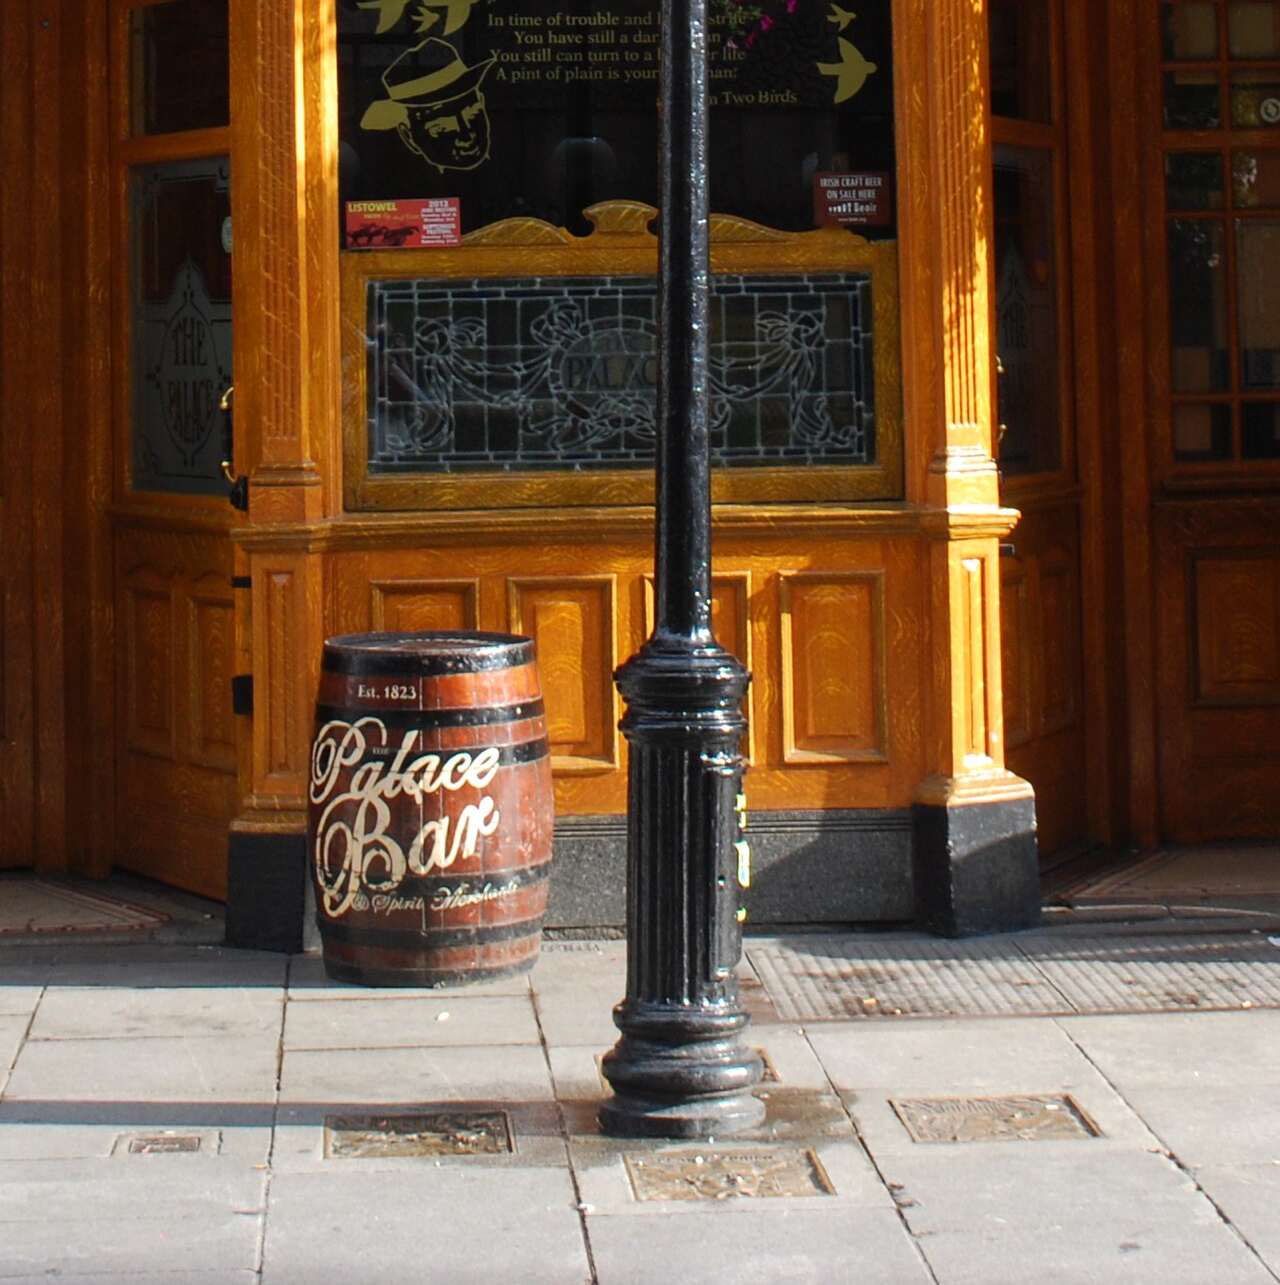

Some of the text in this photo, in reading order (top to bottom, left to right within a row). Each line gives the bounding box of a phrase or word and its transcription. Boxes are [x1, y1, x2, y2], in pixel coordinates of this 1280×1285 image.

[488, 14, 504, 26] In
[509, 13, 542, 26] time
[547, 12, 562, 26] of
[565, 13, 619, 26] trouble
[624, 13, 652, 26] and
[514, 31, 543, 44] You
[548, 31, 583, 44] have
[587, 31, 615, 44] still
[620, 34, 628, 44] a
[490, 49, 519, 62] You
[524, 48, 551, 62] still
[556, 52, 583, 62] can
[588, 51, 620, 62] turn
[624, 51, 639, 62] to
[644, 53, 652, 62] a
[723, 46, 745, 60] life
[496, 68, 507, 80] A
[512, 67, 540, 83] pint
[546, 66, 561, 80] of
[566, 66, 603, 83] plain
[608, 67, 620, 80] is
[624, 70, 658, 84] your
[721, 90, 755, 104] Two
[758, 89, 798, 104] Birds
[820, 177, 882, 187] IRISH CRAFT BEER
[826, 189, 876, 199] ON SALE HERE
[348, 202, 397, 212] LISTOWEL
[173, 317, 207, 366] THE
[563, 356, 657, 388] PALAC
[358, 684, 416, 700] Est. 1823
[310, 716, 499, 804] Palace
[316, 793, 500, 918] Bar
[372, 893, 424, 917] Spirit
[430, 881, 518, 910] Merchants
